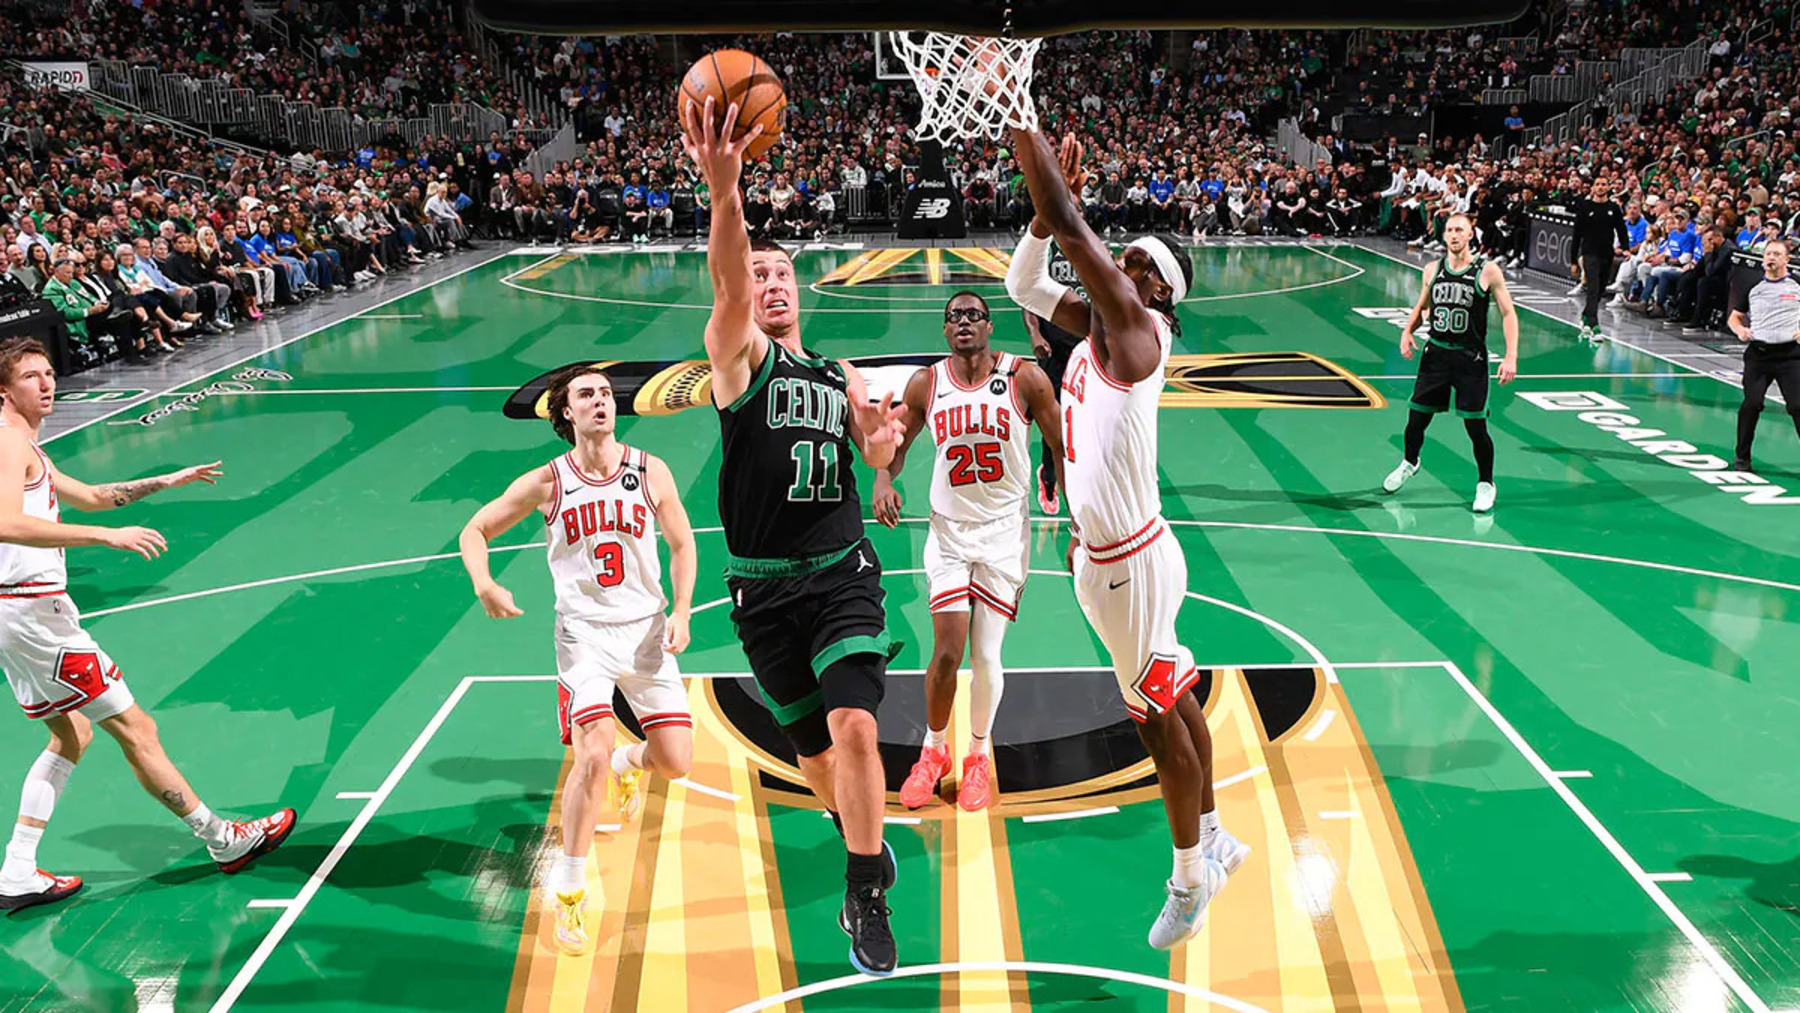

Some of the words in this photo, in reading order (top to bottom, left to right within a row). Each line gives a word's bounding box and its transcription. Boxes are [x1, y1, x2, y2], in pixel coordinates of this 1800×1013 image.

[1432, 281, 1475, 307] CELTICS
[1433, 306, 1469, 333] 30
[767, 377, 848, 438] CELTIC
[934, 403, 1010, 446] BULLS
[787, 440, 842, 501] 11
[946, 442, 1004, 487] 25
[1577, 411, 1800, 505] GARDEN
[562, 499, 646, 546] BULLS
[594, 541, 625, 588] 3
